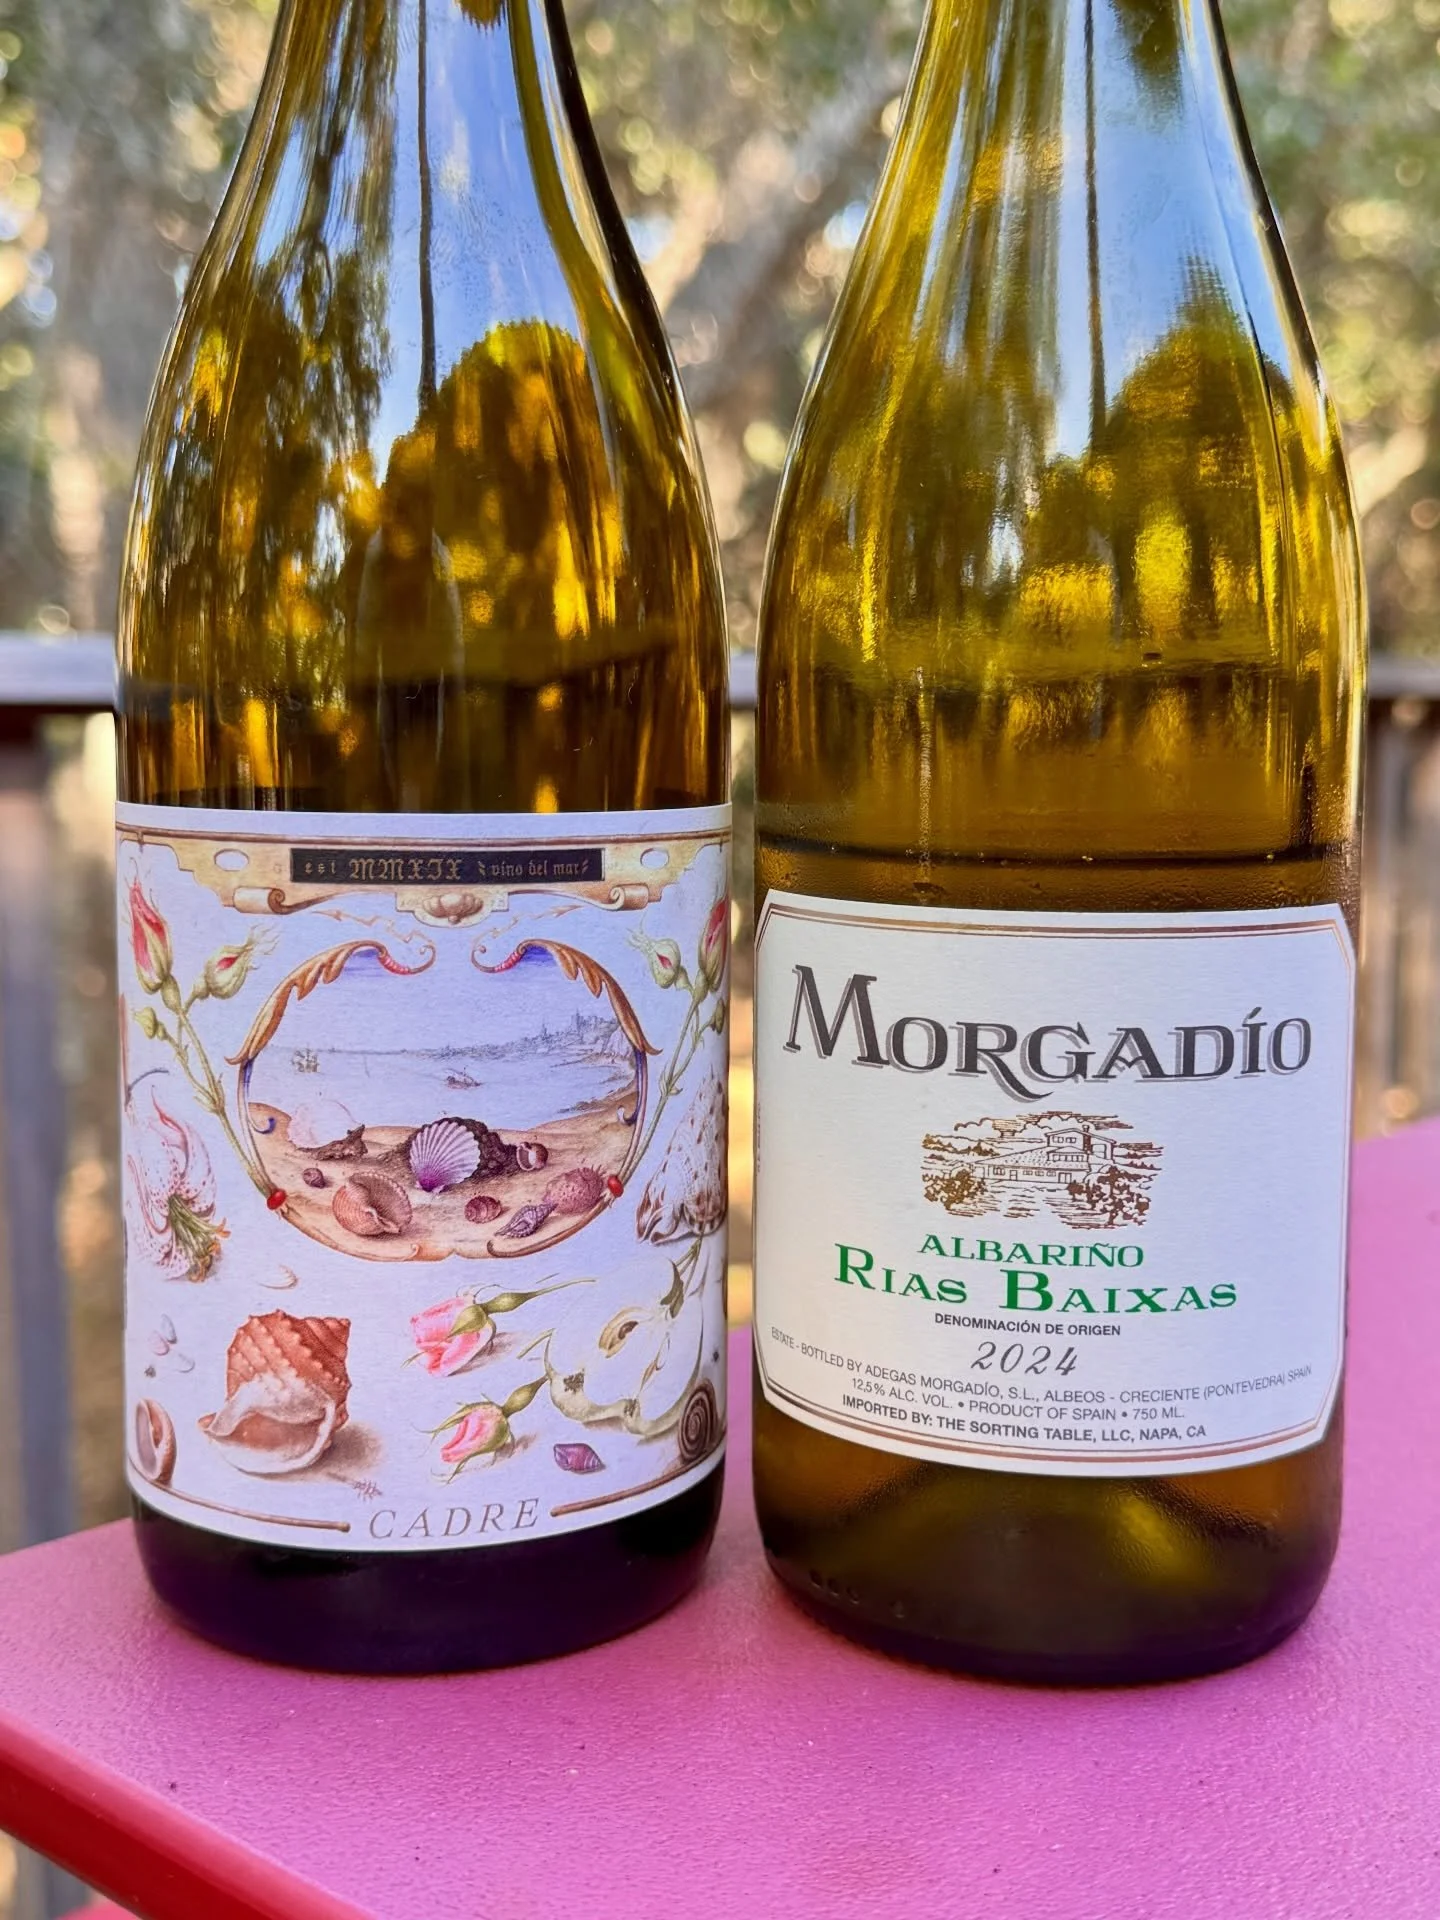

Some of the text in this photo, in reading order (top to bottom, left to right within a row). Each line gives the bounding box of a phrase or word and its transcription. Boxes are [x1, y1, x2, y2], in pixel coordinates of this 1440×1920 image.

[349, 858, 463, 881] MMXIX
[491, 862, 523, 877] vino
[528, 860, 546, 876] del
[553, 863, 580, 876] mar
[917, 1234, 1144, 1268] ALBARIÑO
[935, 1312, 1121, 1336] DENOMINACIÓN DE ORIGEN
[801, 1342, 844, 1368] BOTTLED
[847, 1357, 862, 1373] BY
[865, 1364, 916, 1386] ADEGAS
[920, 1376, 1003, 1400] MORGADÍO,
[1008, 1388, 1039, 1402] S.L.,
[1044, 1390, 1105, 1403] ALBEOS
[1120, 1388, 1200, 1403] CRECIENTE
[970, 1341, 1079, 1376] 2024
[843, 1394, 1207, 1443] IMPORTED BY: THE SORTING TABLE, LLC, NAPA, CA
[888, 1387, 917, 1402] ALC.
[922, 1394, 952, 1408] VOL.
[969, 1401, 1042, 1420] PRODUCT
[1047, 1407, 1068, 1419] OF
[1072, 1407, 1116, 1420] SPAIN
[1133, 1406, 1158, 1419] 750
[1162, 1406, 1185, 1418] ML.
[369, 1498, 539, 1540] CADRE
